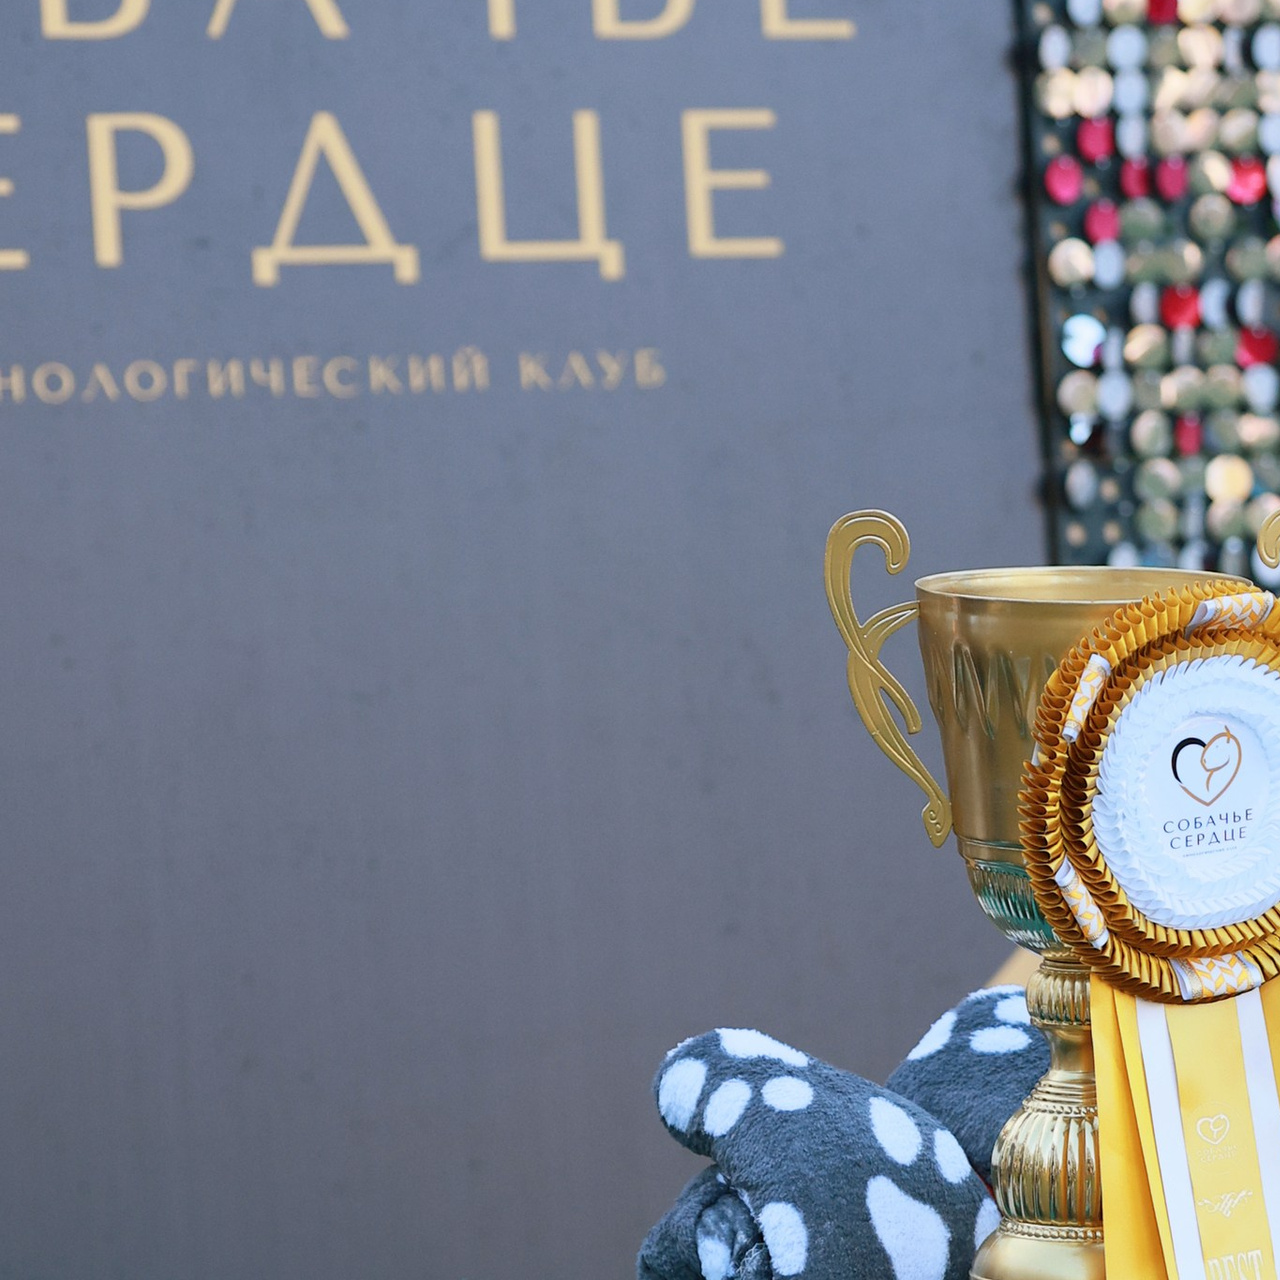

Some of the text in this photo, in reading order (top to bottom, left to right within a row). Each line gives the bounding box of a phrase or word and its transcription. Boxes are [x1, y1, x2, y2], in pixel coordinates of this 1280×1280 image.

[0, 110, 784, 286] РДЦЕ
[517, 347, 668, 393] КЛУБ
[1163, 808, 1253, 834] СОБАЧЬЕ
[1170, 826, 1247, 850] СЕРДЦЕ
